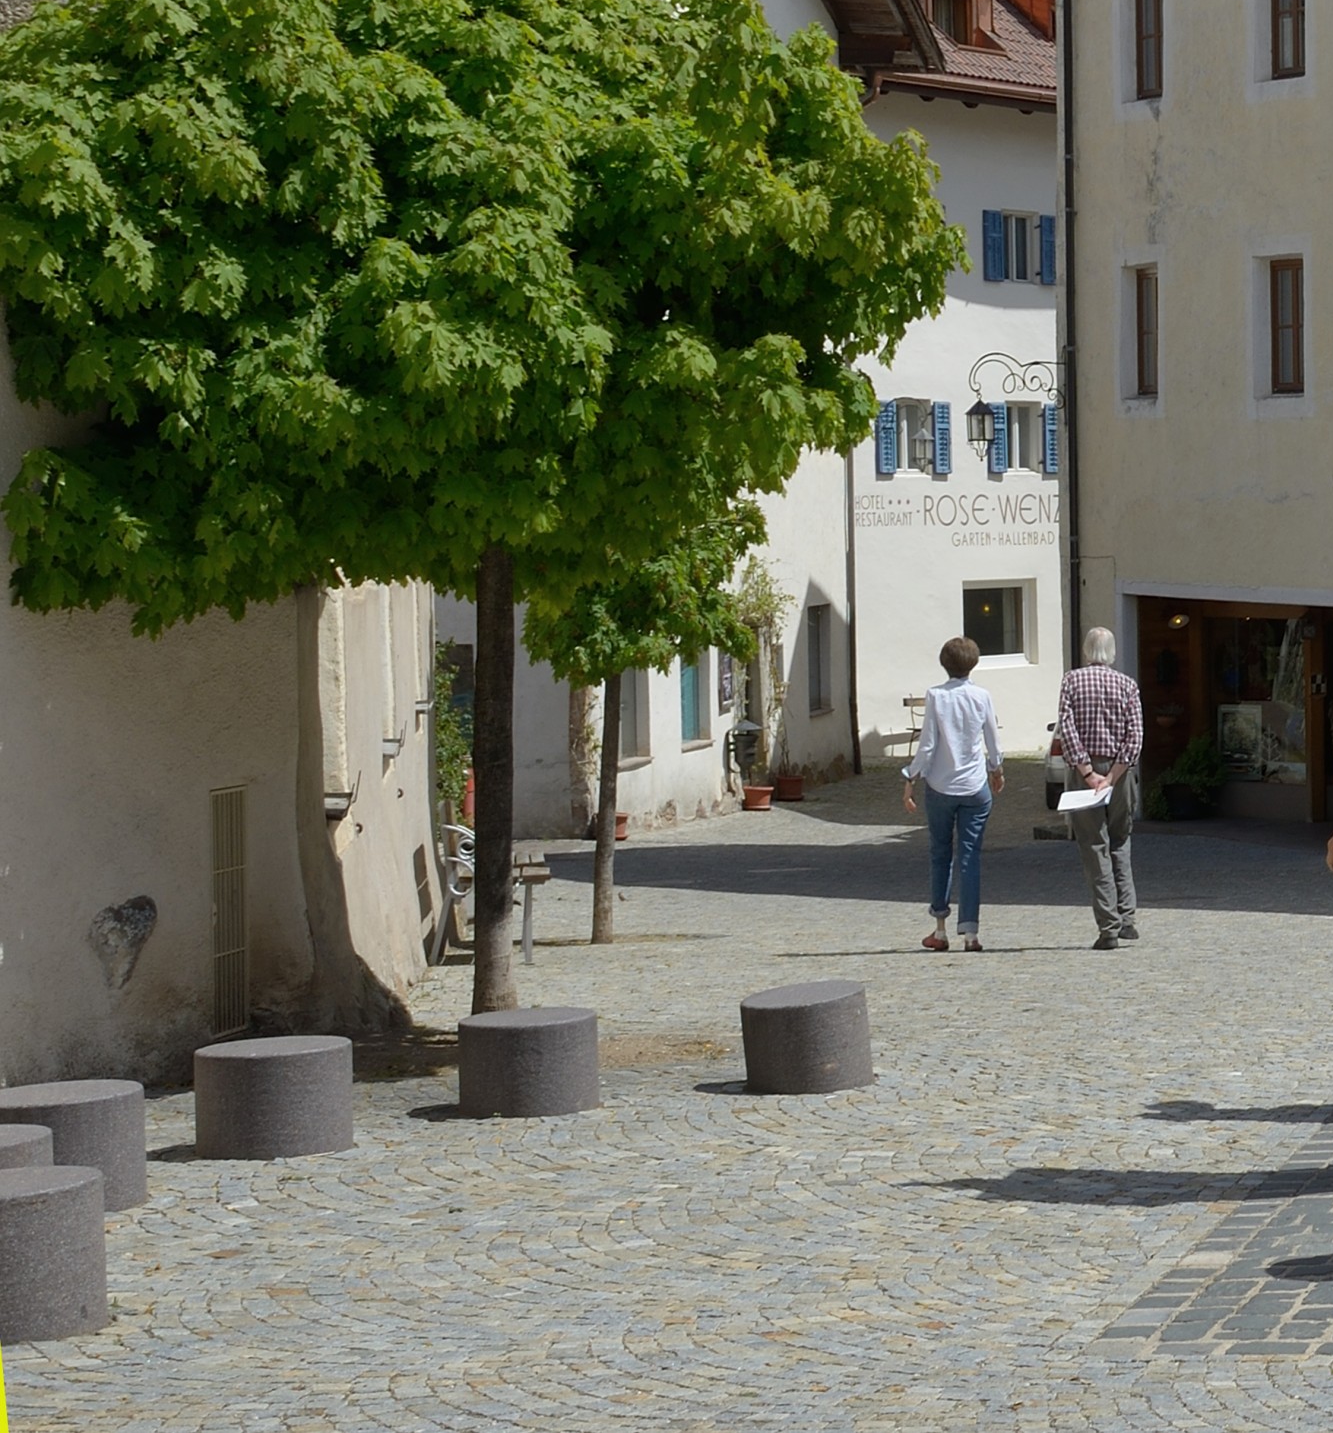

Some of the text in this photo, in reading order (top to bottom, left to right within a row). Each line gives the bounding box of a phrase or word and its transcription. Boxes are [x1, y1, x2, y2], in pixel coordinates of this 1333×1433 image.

[855, 495, 886, 510] HOTEL
[924, 494, 990, 526] ROSE
[855, 512, 912, 527] RESTAURANT
